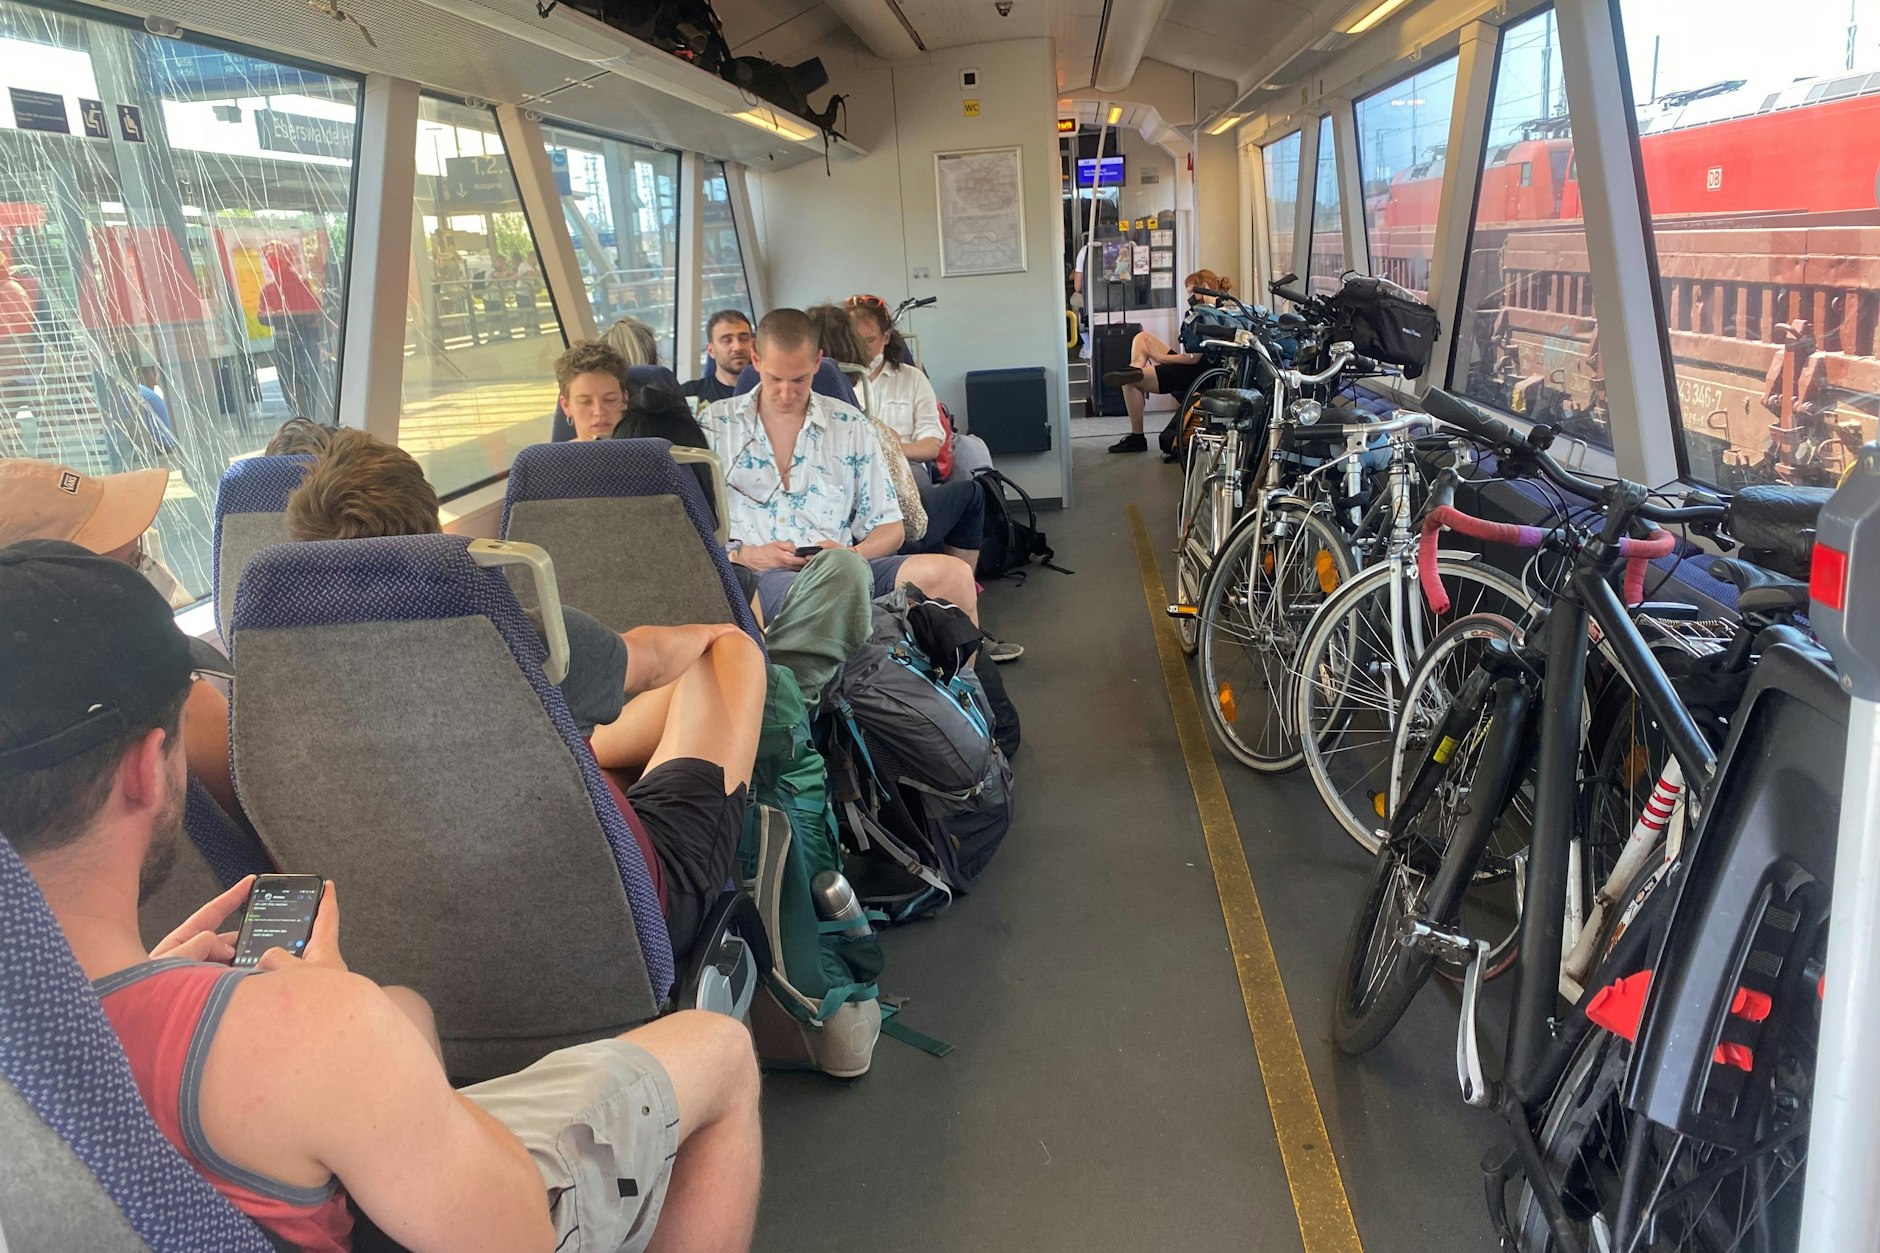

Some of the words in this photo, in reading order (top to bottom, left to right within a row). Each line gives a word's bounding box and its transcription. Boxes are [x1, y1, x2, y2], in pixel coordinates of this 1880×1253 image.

[965, 104, 979, 112] WC
[273, 118, 340, 145] Eberswalde
[1709, 170, 1720, 186] DB
[63, 474, 78, 490] VANS
